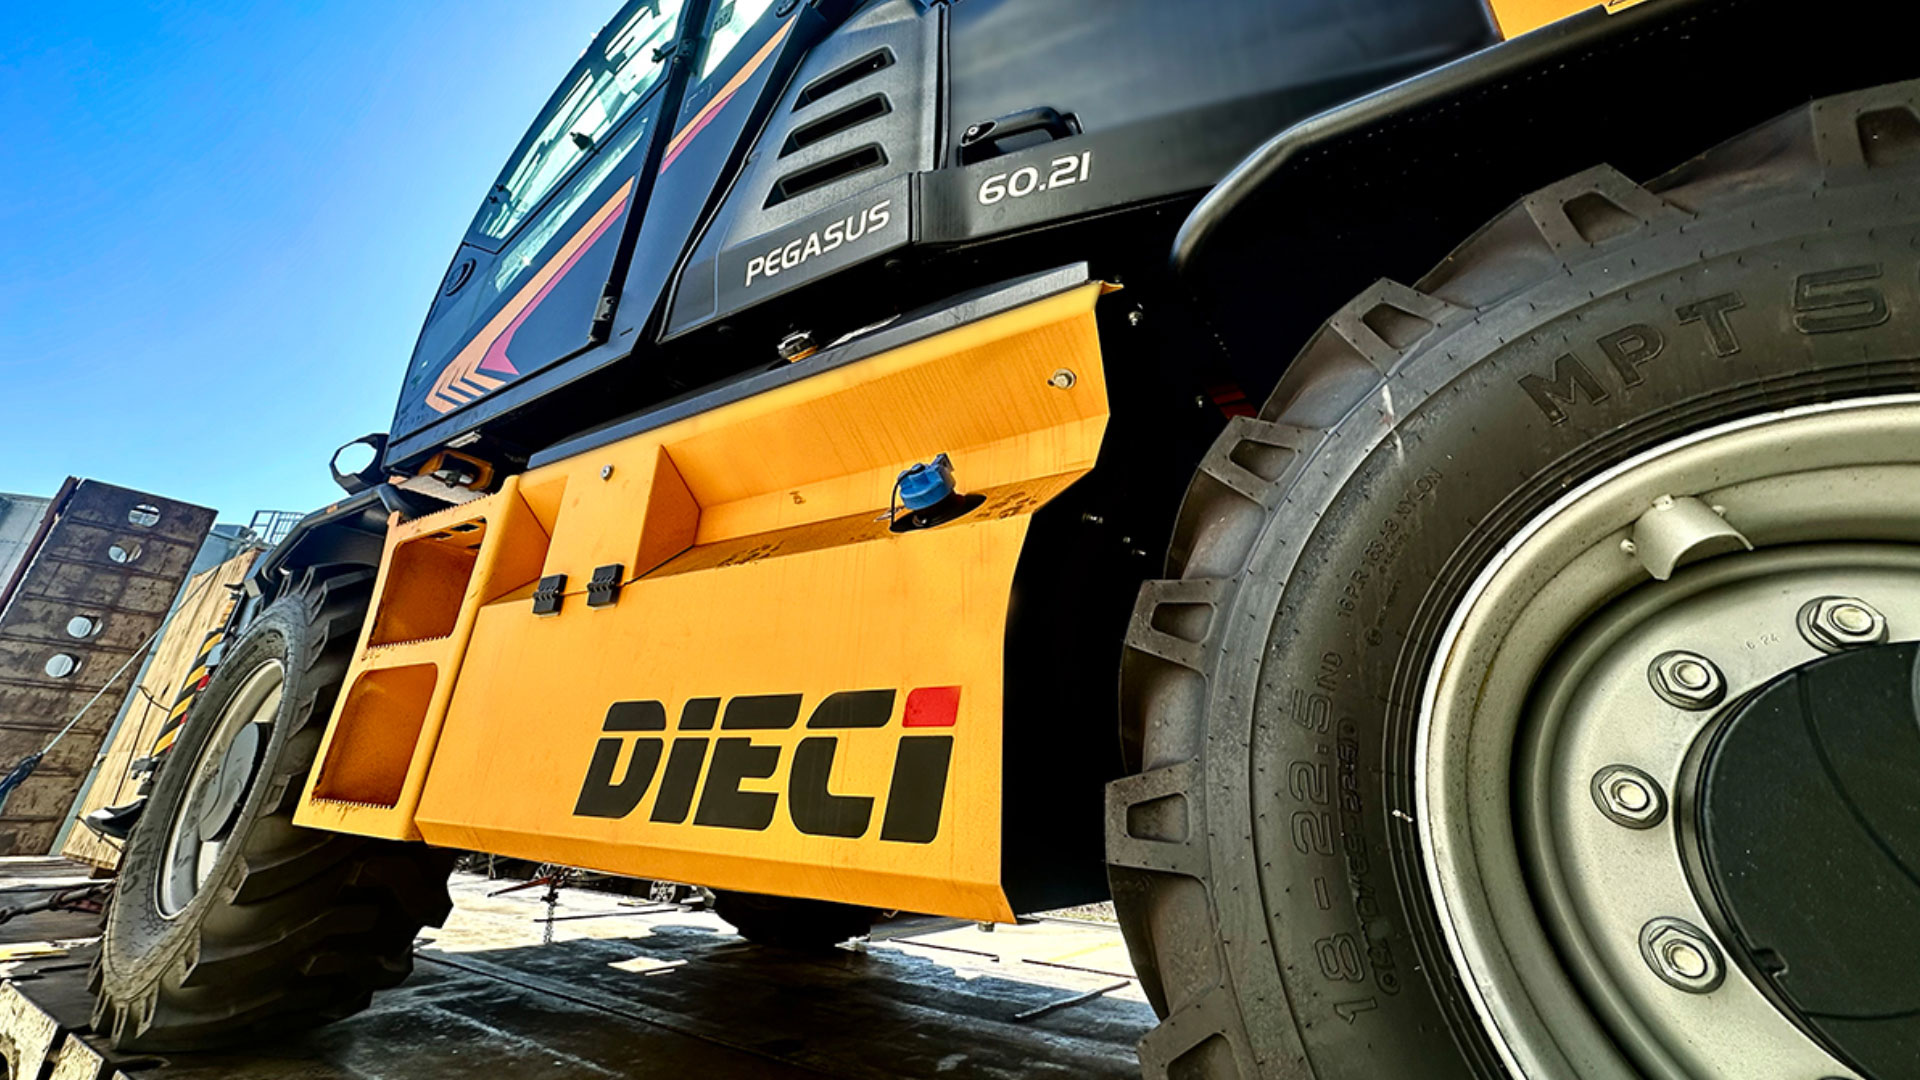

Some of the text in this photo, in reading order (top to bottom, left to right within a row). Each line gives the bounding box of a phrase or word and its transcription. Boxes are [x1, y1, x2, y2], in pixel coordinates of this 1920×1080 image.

[977, 150, 1093, 205] 60.21
[745, 200, 892, 288] PEGASUS
[1516, 289, 1746, 426] MPT
[1397, 467, 1443, 521] NYLON
[1316, 650, 1344, 692] IND
